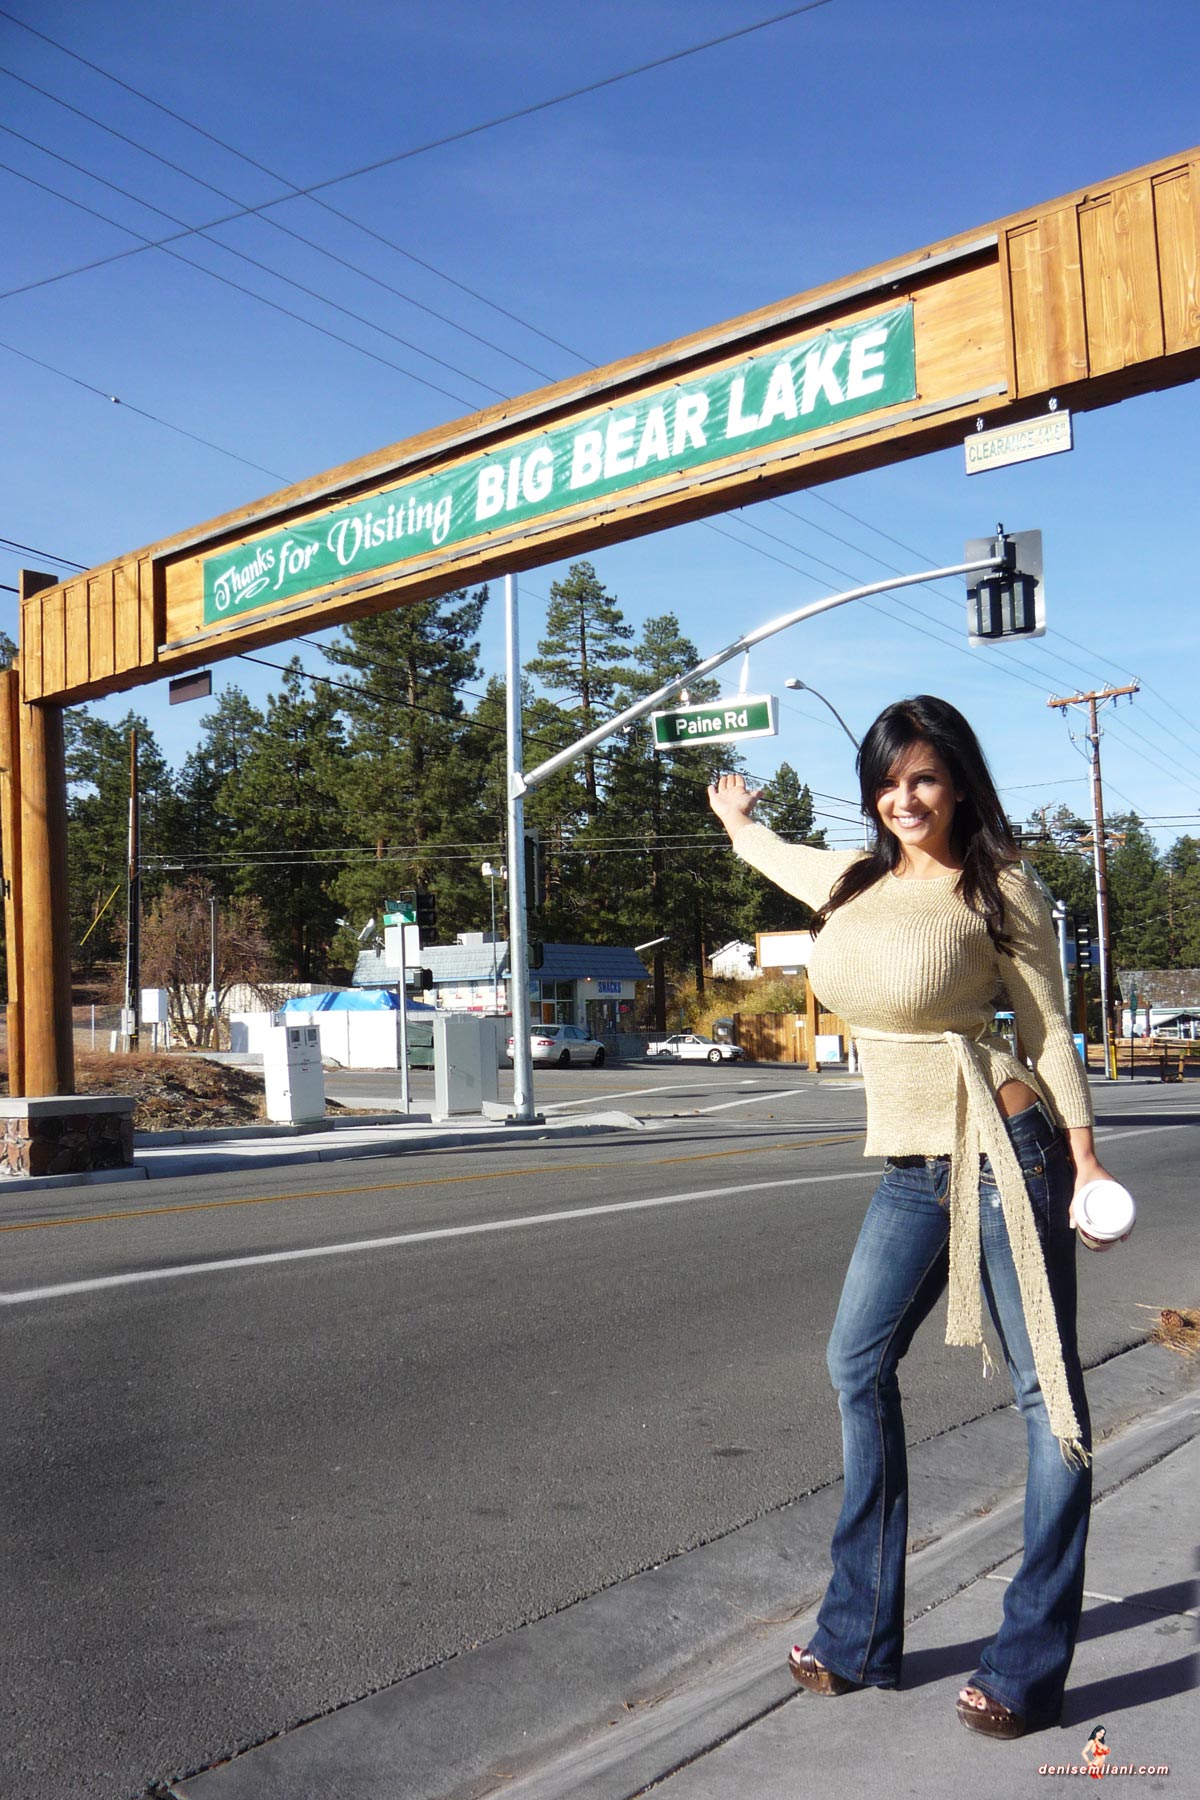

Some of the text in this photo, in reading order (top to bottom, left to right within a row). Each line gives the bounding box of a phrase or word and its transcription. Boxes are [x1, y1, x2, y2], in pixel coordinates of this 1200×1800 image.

[968, 431, 1034, 462] CLEARANCE
[214, 328, 888, 611] Thanks for Visiting BIG BEAR LAKE
[676, 709, 748, 736] Paine Rd
